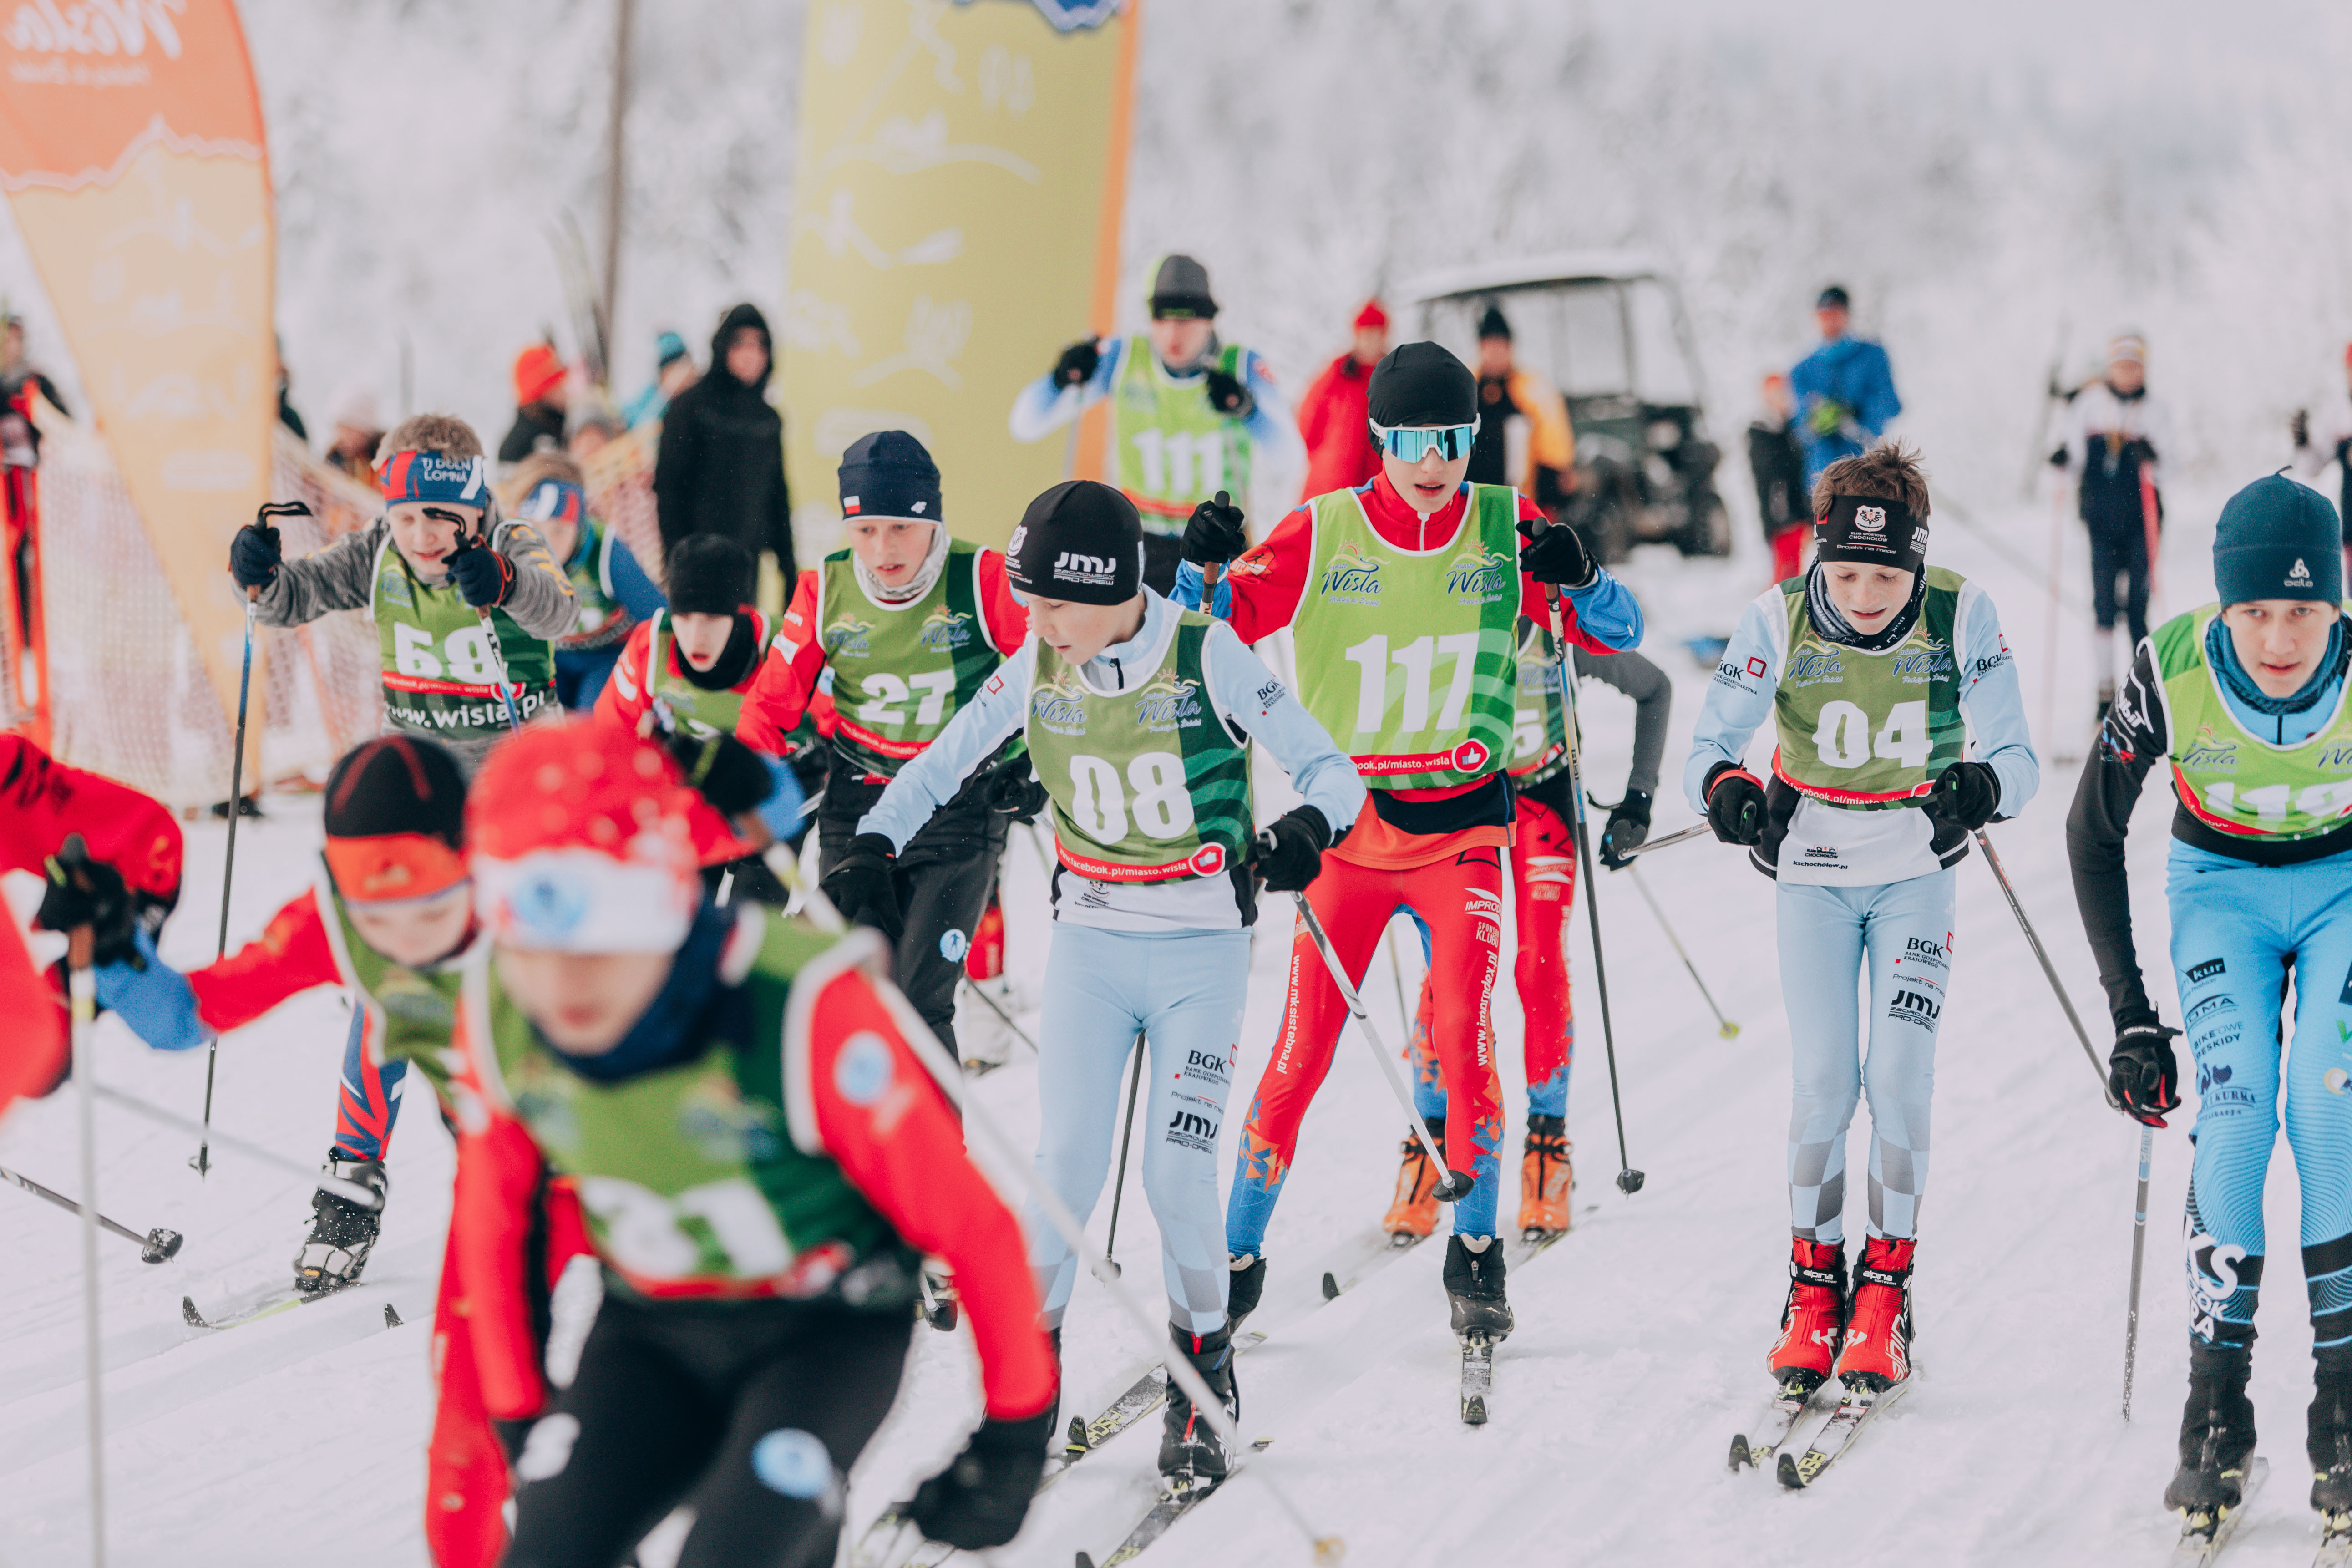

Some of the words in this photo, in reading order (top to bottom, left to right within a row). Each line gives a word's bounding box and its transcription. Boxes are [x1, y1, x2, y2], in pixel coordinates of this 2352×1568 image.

[1132, 428, 1222, 499] 111
[1345, 633, 1480, 733] 117
[1723, 677, 1757, 695] GOSPODARSTWA
[858, 669, 957, 725] 27
[1812, 700, 1934, 769] 04
[1070, 752, 1194, 845] 08
[1059, 847, 1187, 877] www.facebook.pl/miasto.wisla
[1793, 860, 1848, 870] kschocholow.pl
[1476, 929, 1499, 948] KLUBU
[1907, 937, 1944, 959] BGK
[1904, 956, 1938, 969] KRAJOWEGO
[1892, 974, 1922, 985] Projekt
[1276, 954, 1300, 1075] www.mksistebna.pl
[1477, 949, 1498, 1067] www.improdex.pl
[1888, 1013, 1934, 1034] PRO-DREW
[1186, 1066, 1201, 1074] BANK
[1188, 1049, 1227, 1075] BGK
[1184, 1071, 1219, 1086] KRAJOWEGO
[1171, 1091, 1202, 1105] Projekt
[1166, 1137, 1213, 1155] PRO-DREW
[1803, 1269, 1834, 1280] alpina
[1863, 1270, 1893, 1282] alpina
